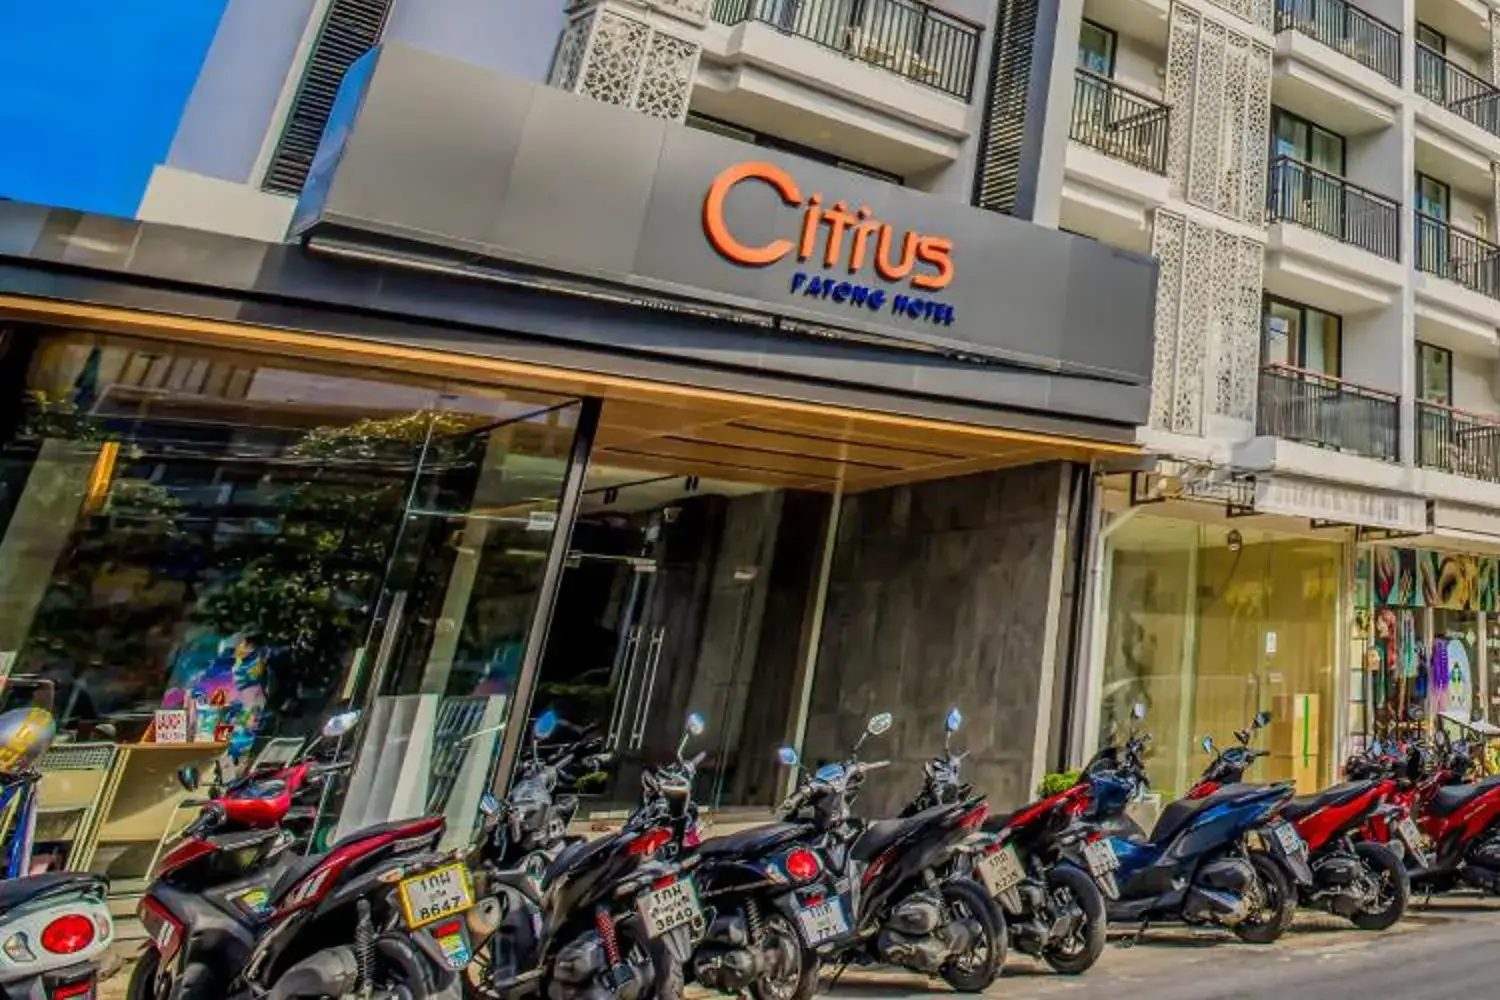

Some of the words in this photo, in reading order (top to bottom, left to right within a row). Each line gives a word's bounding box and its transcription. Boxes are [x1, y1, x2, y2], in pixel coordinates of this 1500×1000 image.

[703, 161, 955, 290] Citrus
[790, 272, 886, 312] PATONG
[891, 293, 955, 327] HOTEL
